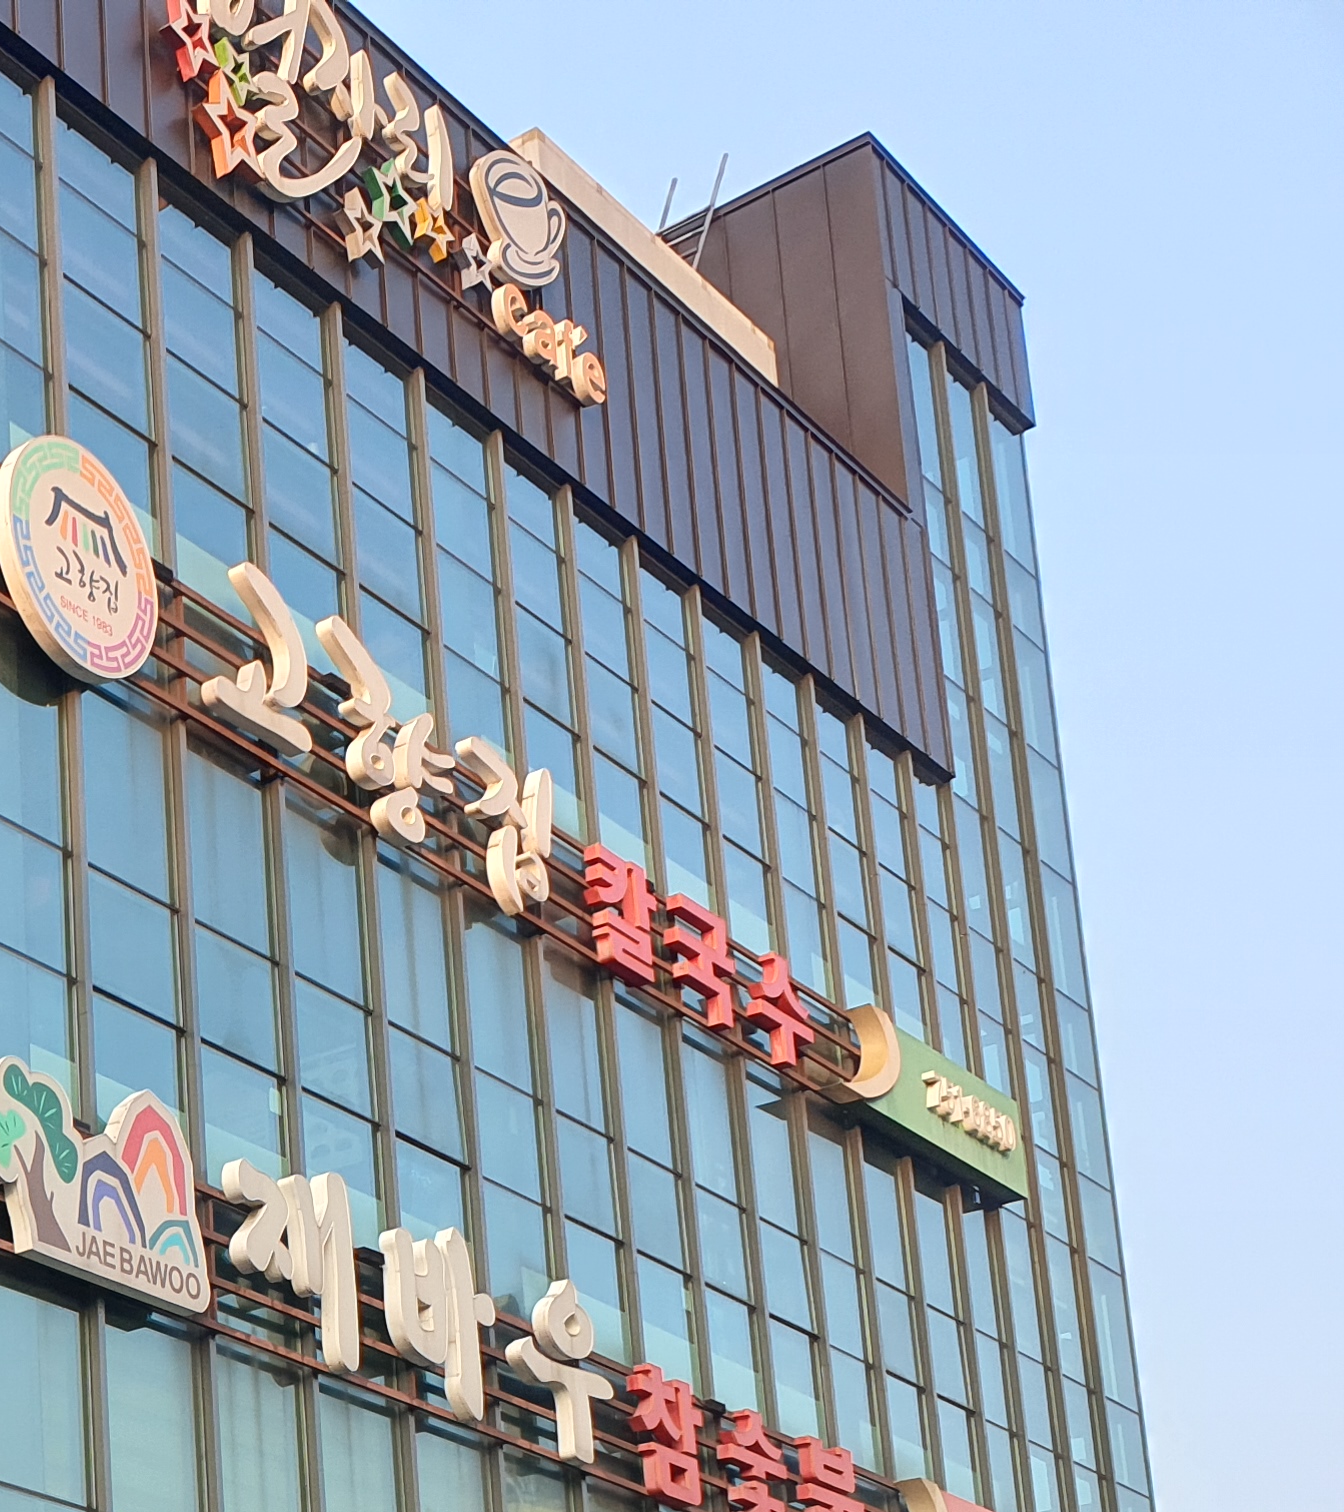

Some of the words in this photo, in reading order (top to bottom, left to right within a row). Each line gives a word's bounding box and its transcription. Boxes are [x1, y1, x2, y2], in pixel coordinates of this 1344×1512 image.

[491, 283, 606, 407] cafe
[55, 546, 119, 615] 고향집
[60, 594, 89, 623] SINCE
[92, 614, 113, 637] 1983
[201, 561, 554, 915] 고향집
[583, 842, 814, 1068] 칼국수
[221, 1156, 614, 1465] 재바우
